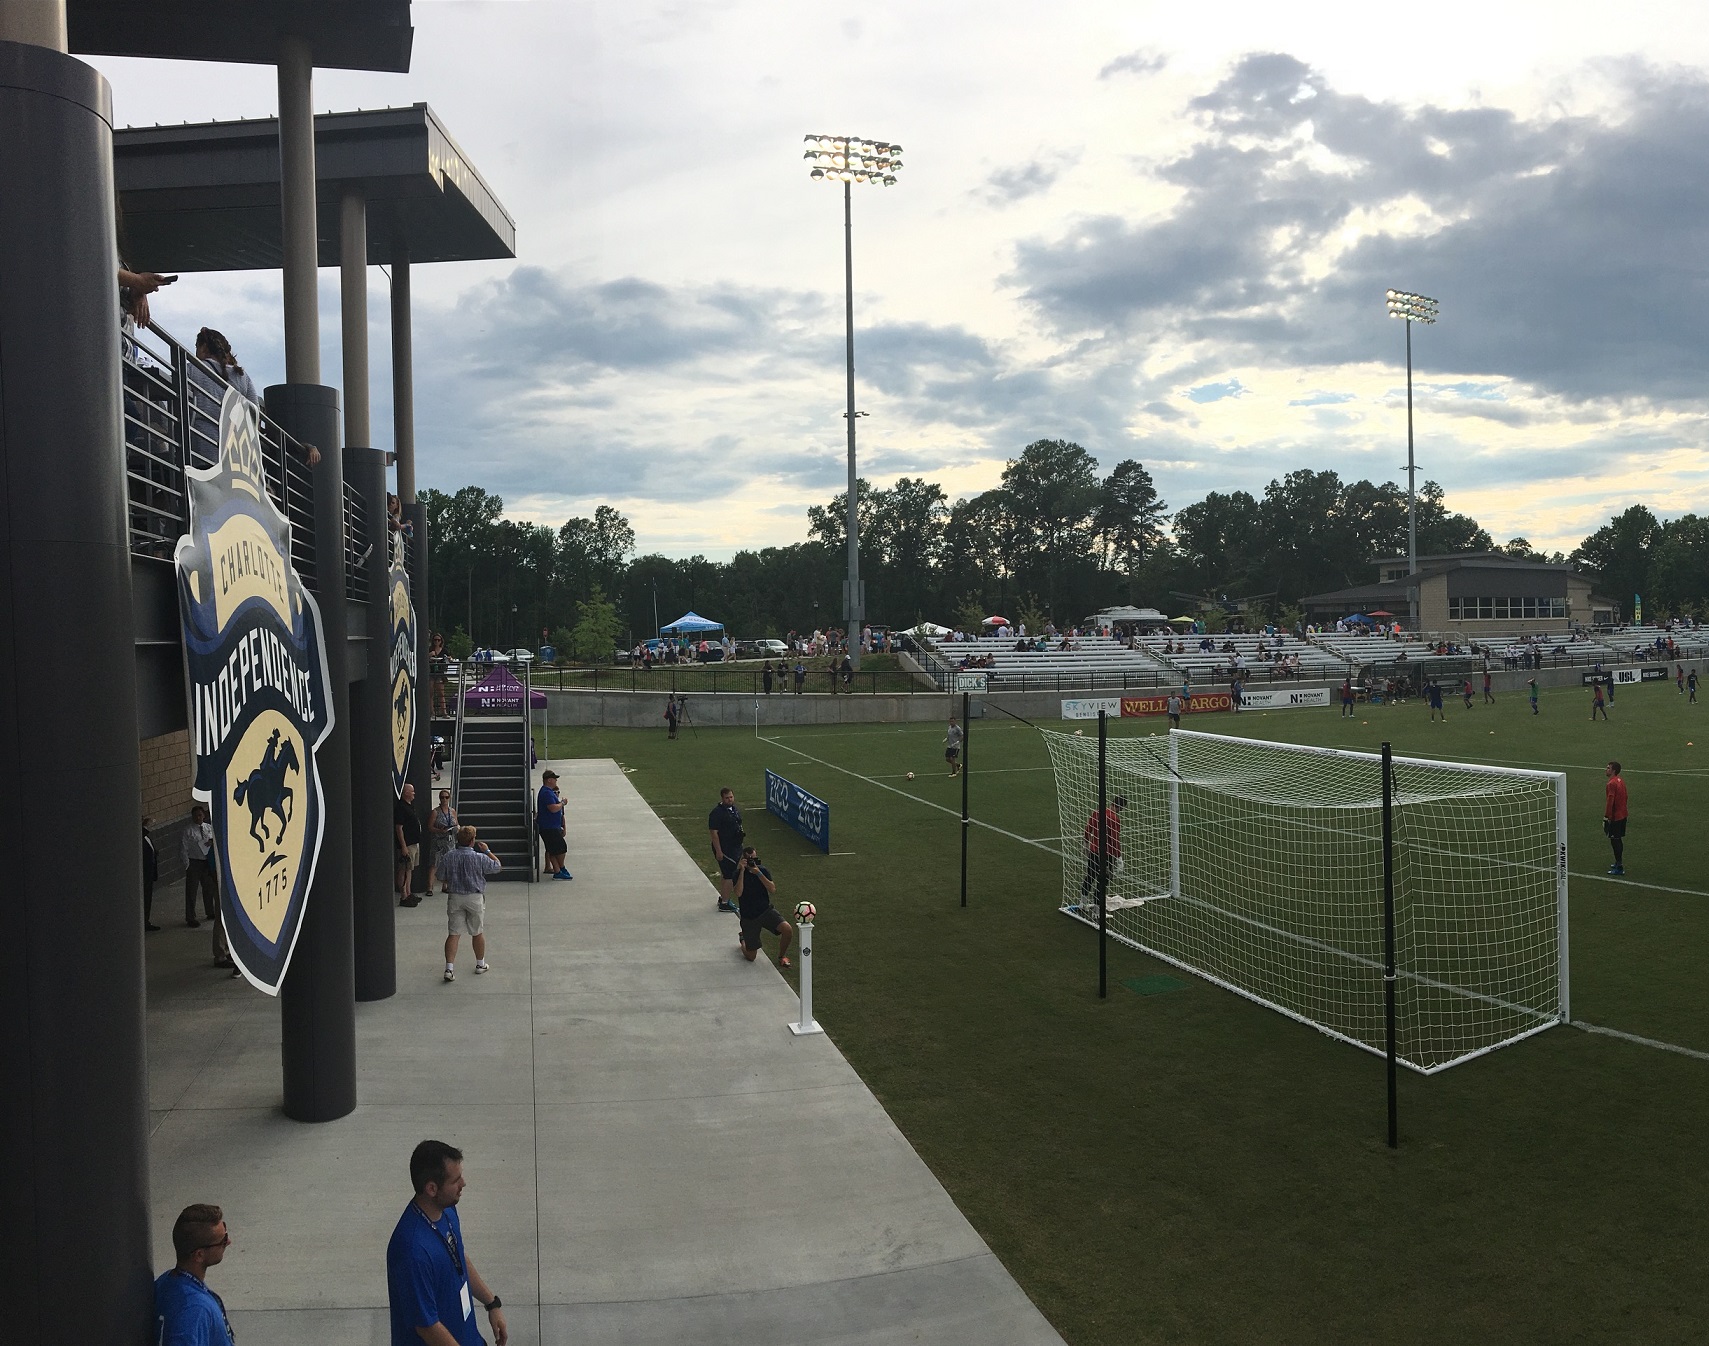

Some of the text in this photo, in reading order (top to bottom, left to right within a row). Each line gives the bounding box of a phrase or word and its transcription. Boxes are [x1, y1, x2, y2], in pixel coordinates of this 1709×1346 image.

[220, 540, 285, 604] CHARLOTTE
[195, 627, 315, 756] INDEPENDENCE
[1065, 701, 1117, 711] SKYVIEW
[1125, 696, 1230, 712] WELL ARGO
[768, 774, 789, 811] ZICO
[797, 791, 822, 834] ZICO
[258, 867, 288, 910] 1775
